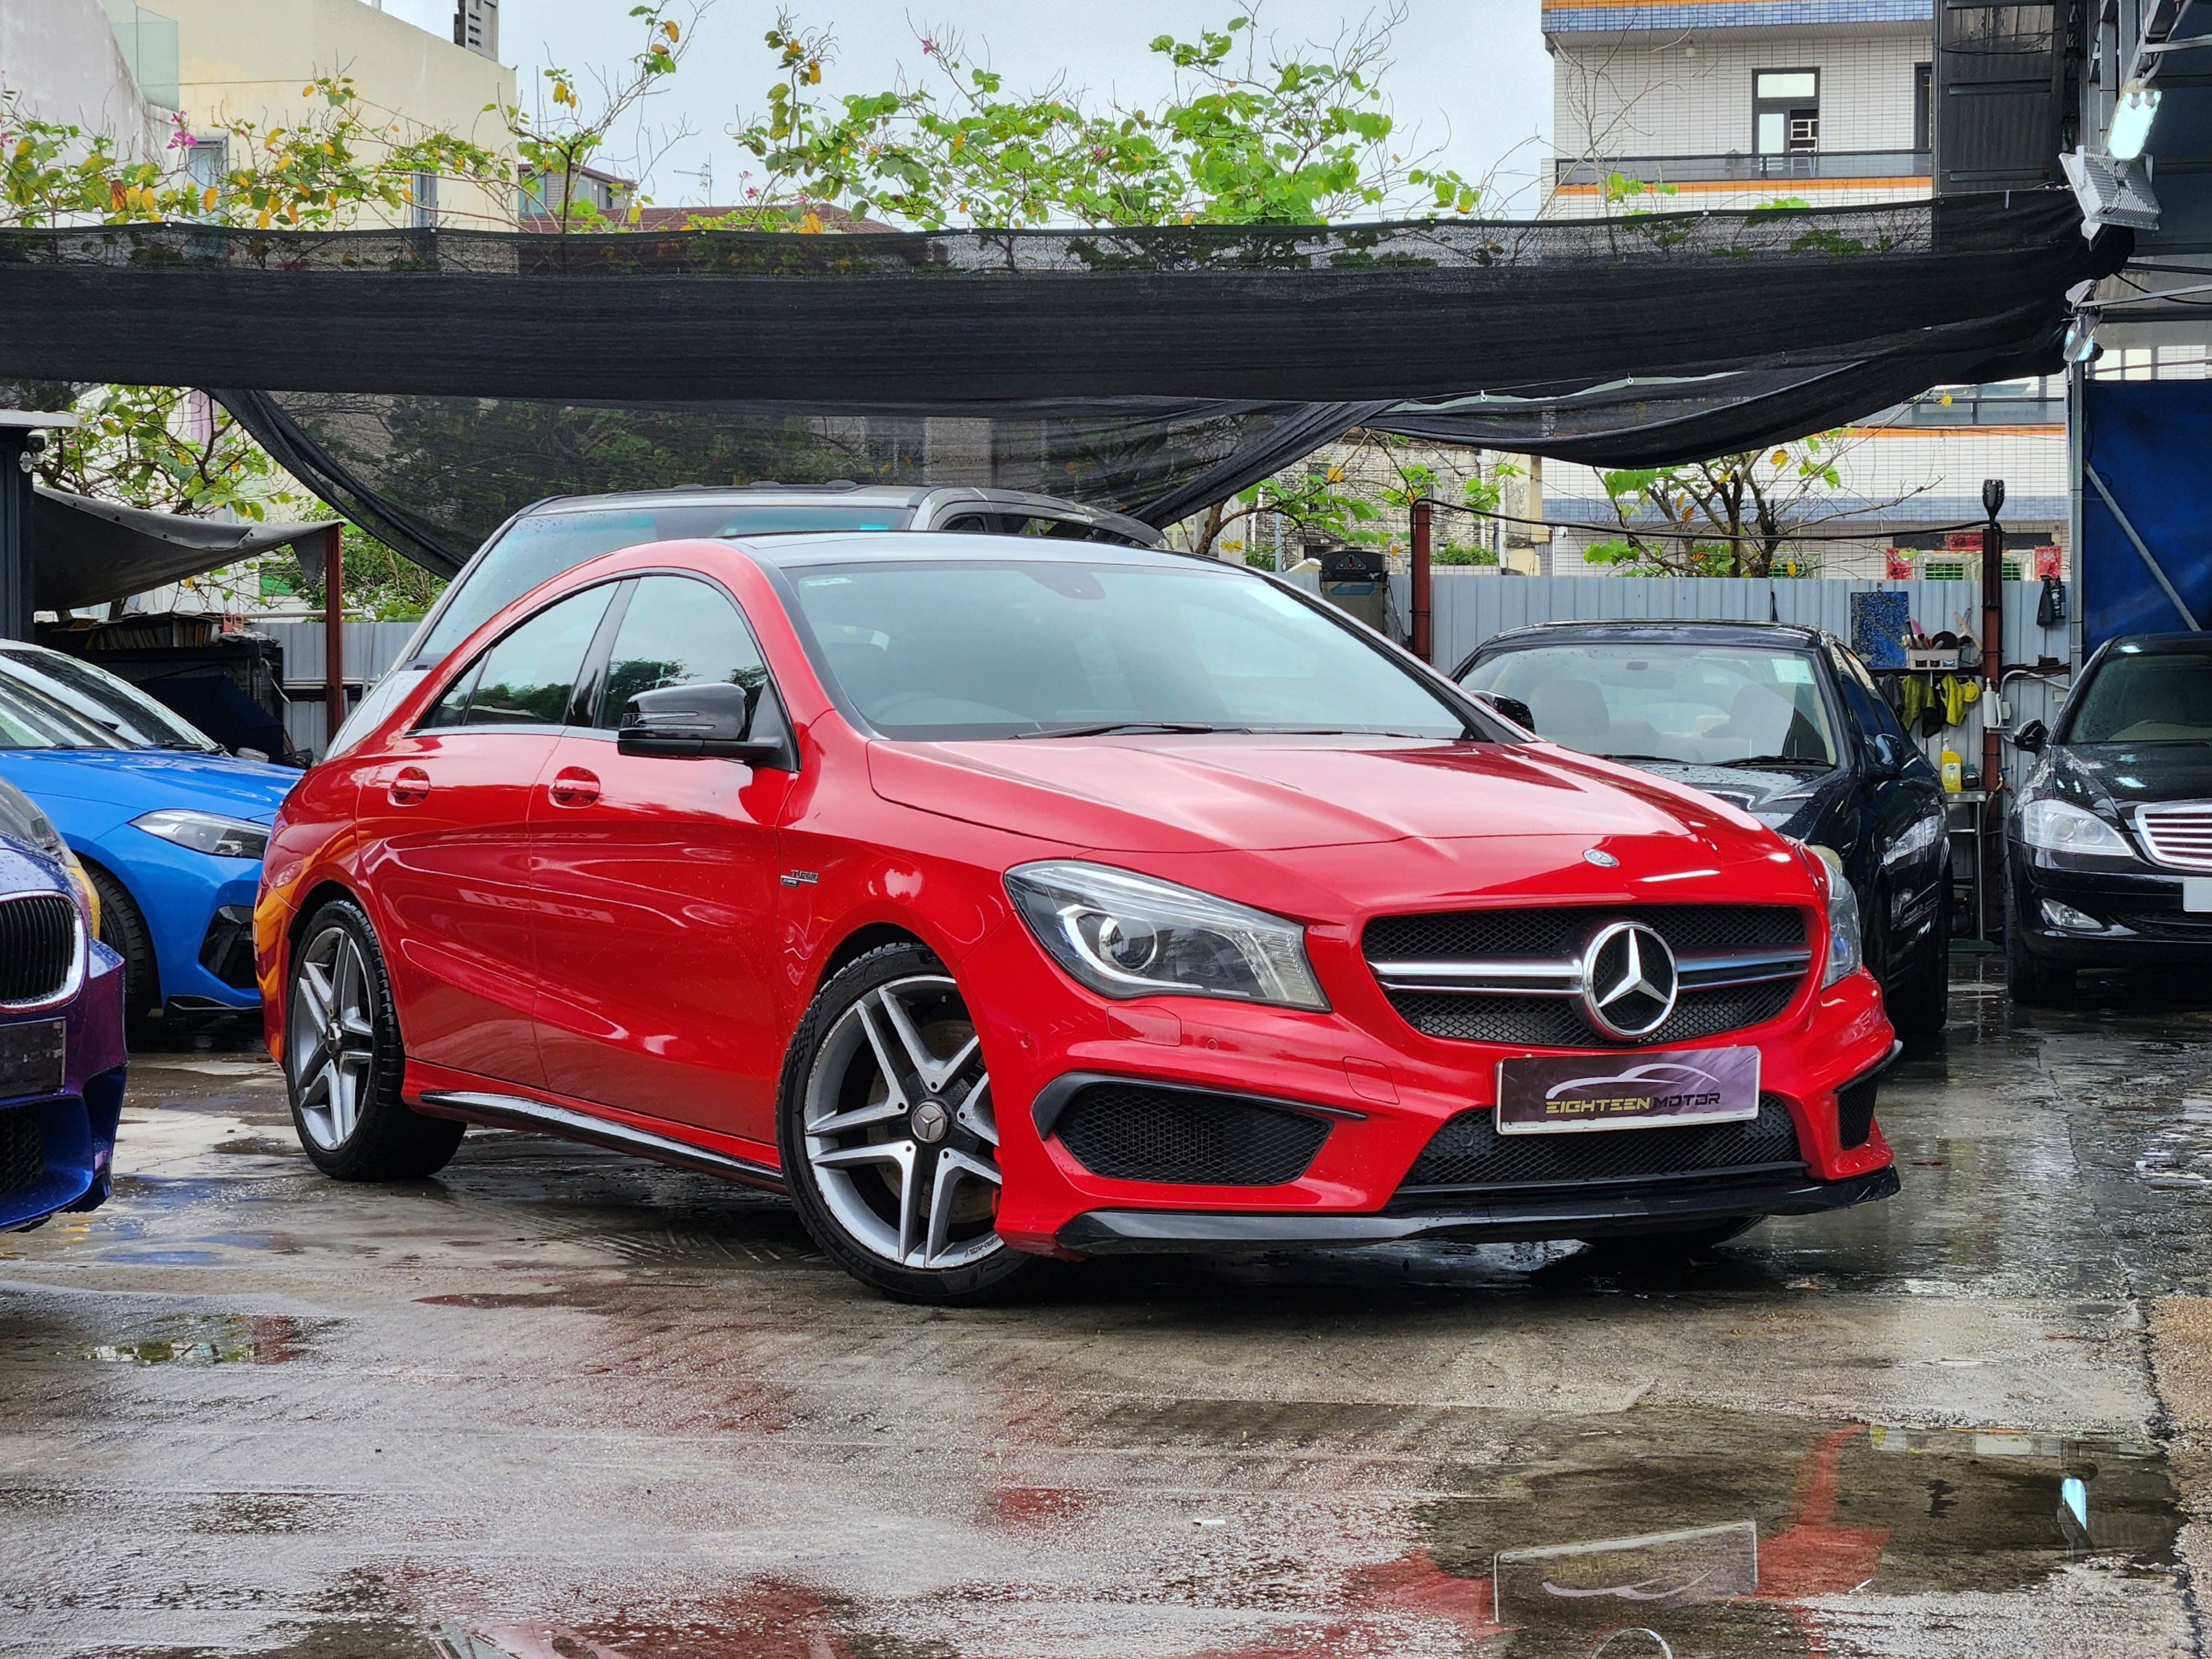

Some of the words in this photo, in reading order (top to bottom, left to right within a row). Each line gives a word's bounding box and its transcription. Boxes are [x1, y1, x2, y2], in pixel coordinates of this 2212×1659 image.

[1546, 1097, 1651, 1114] EIGHTEEN
[1653, 1092, 1720, 1107] MOTOR
[969, 1237, 995, 1255] AMG
